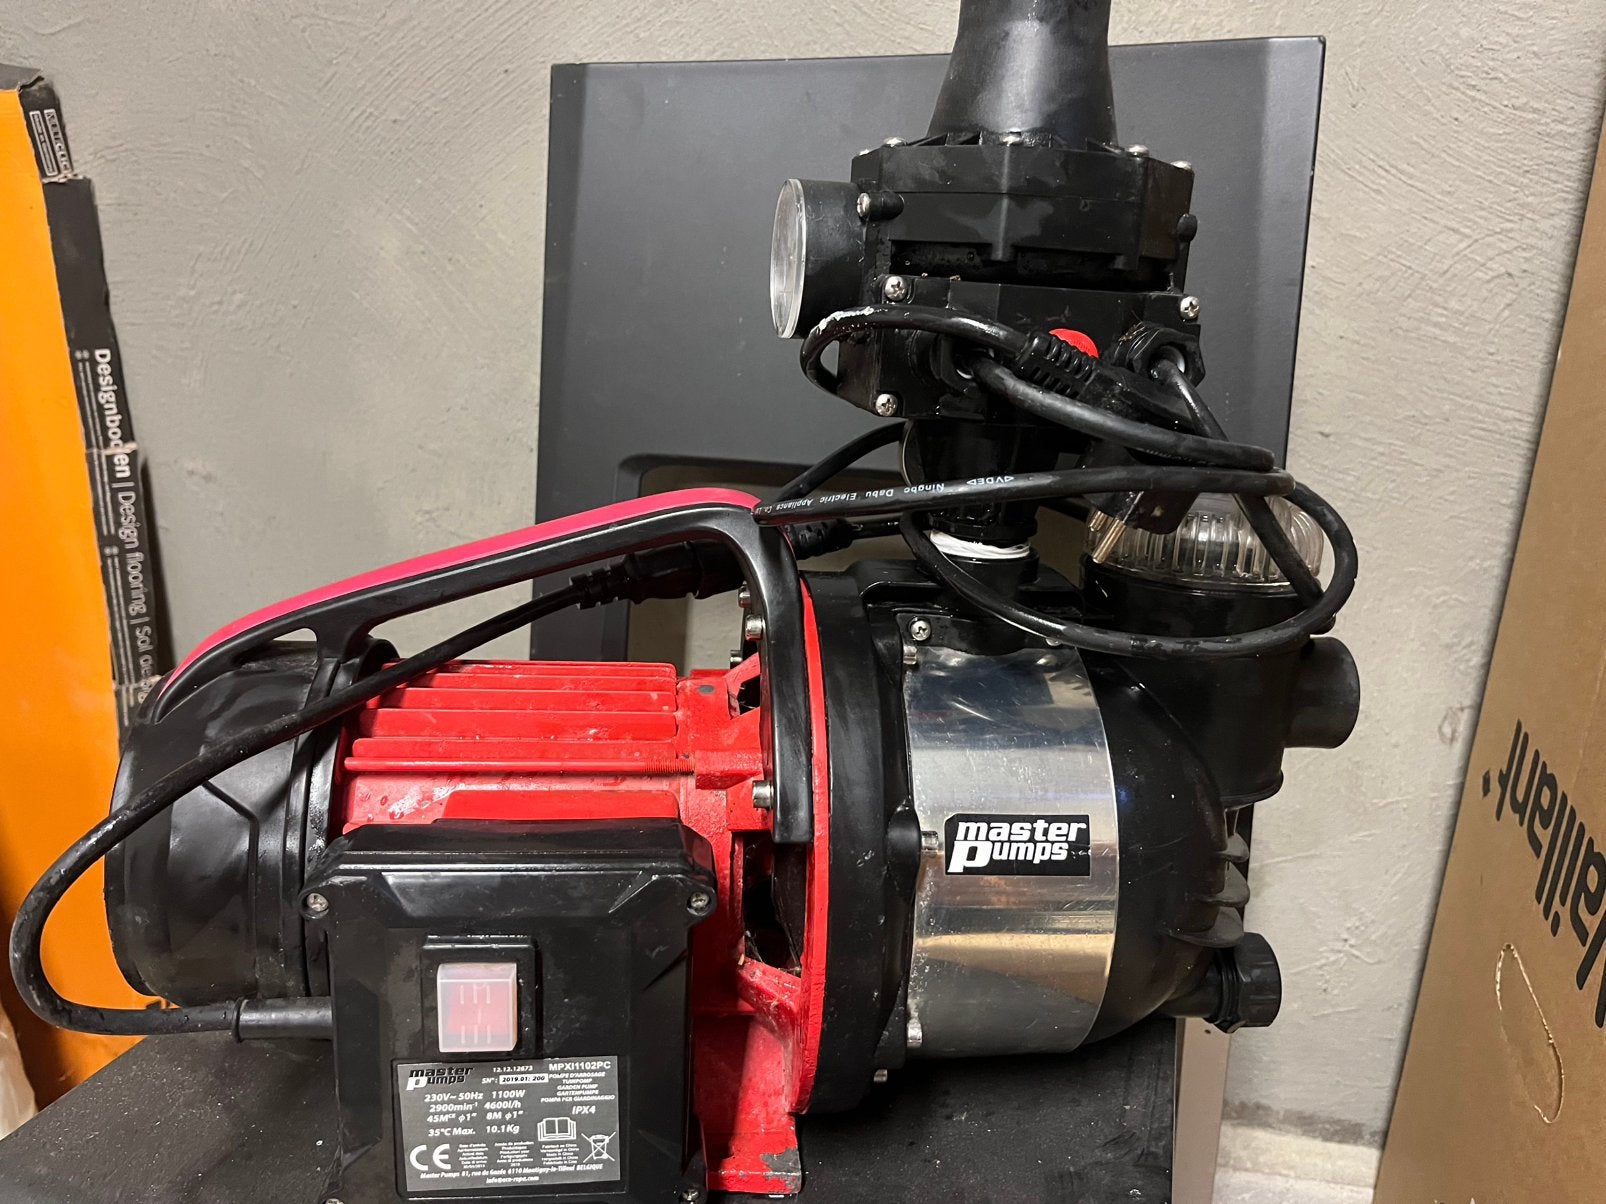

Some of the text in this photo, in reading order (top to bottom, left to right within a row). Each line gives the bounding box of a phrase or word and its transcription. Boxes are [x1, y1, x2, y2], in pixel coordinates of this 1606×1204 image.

[865, 488, 894, 497] Dabu
[903, 483, 945, 494] Ningbo
[775, 498, 814, 510] Appliance
[819, 492, 857, 504] Electric
[117, 491, 141, 549] Design
[125, 552, 149, 616] flooring
[135, 625, 153, 652] Sol
[955, 819, 1087, 841] master
[409, 1066, 474, 1078] master
[457, 1091, 484, 1100] 50Hz
[491, 1089, 526, 1098] 1100W
[571, 1105, 596, 1115] IPX4
[452, 1127, 476, 1136] Max.
